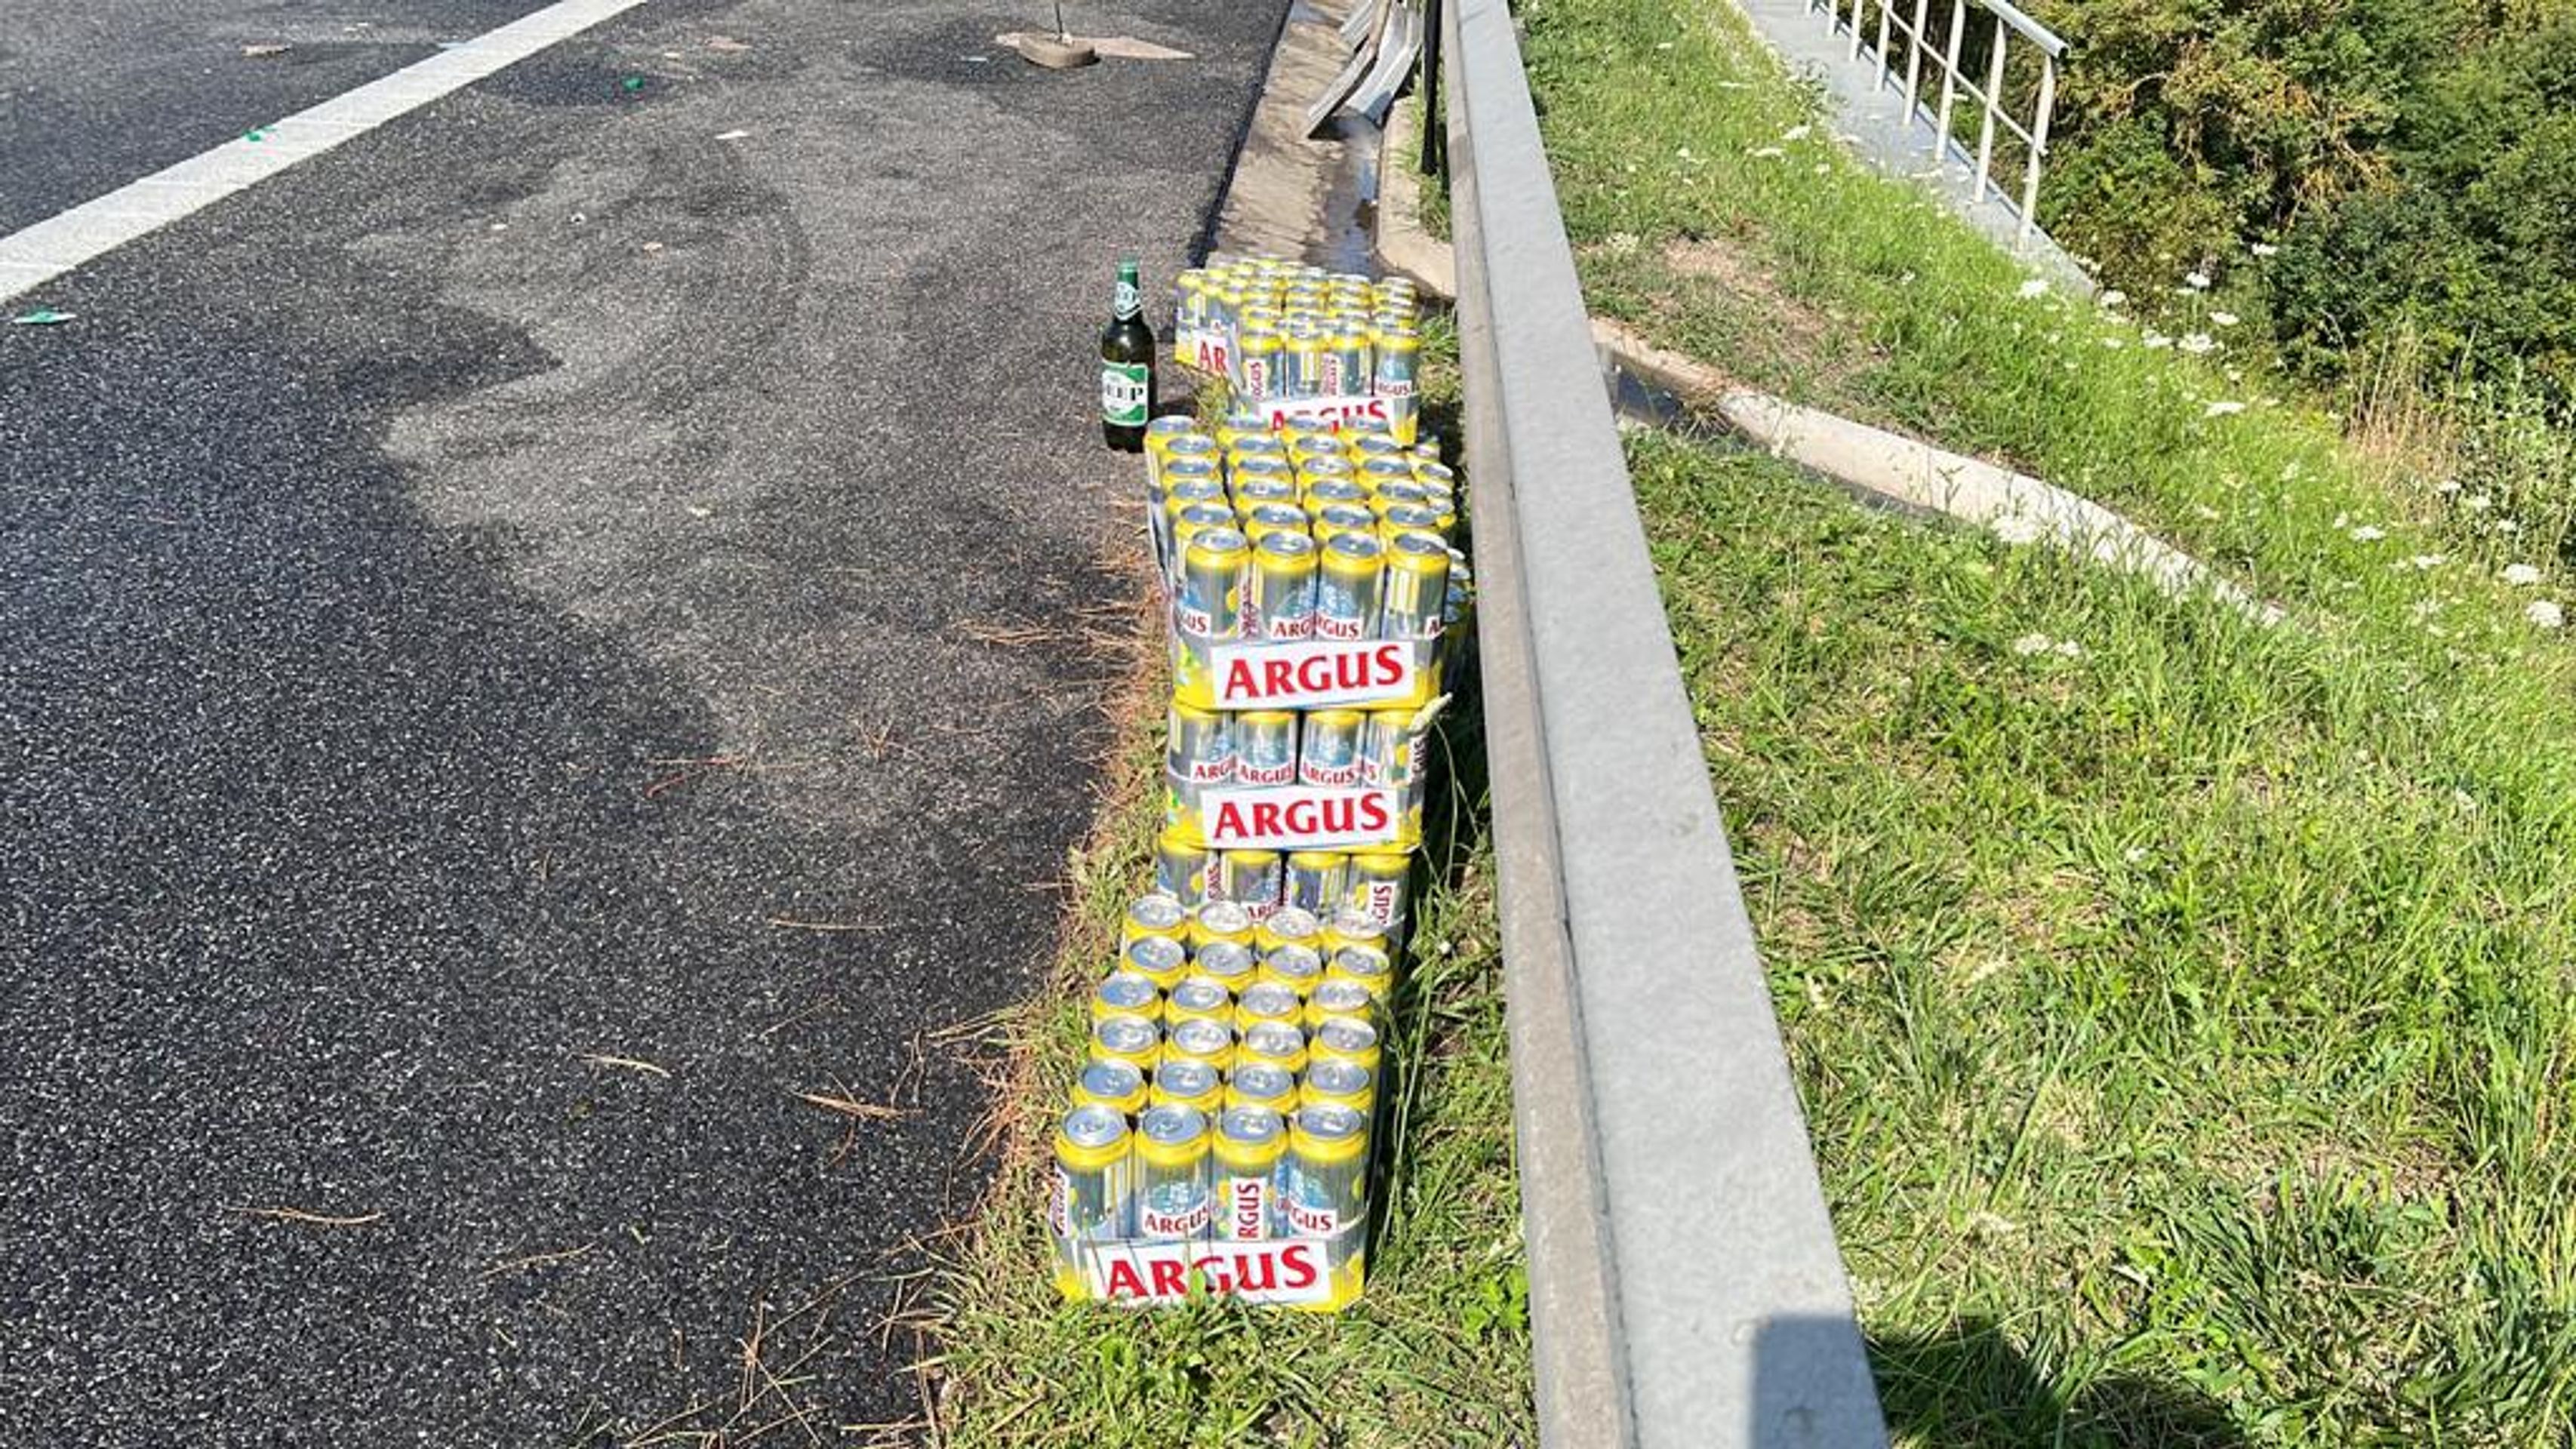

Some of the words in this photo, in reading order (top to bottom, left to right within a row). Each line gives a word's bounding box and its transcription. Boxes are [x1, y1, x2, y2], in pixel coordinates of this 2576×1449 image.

[1224, 645, 1403, 700] ARGUS
[1214, 792, 1388, 838] ARGUS
[1107, 1245, 1317, 1297] ARGUS
